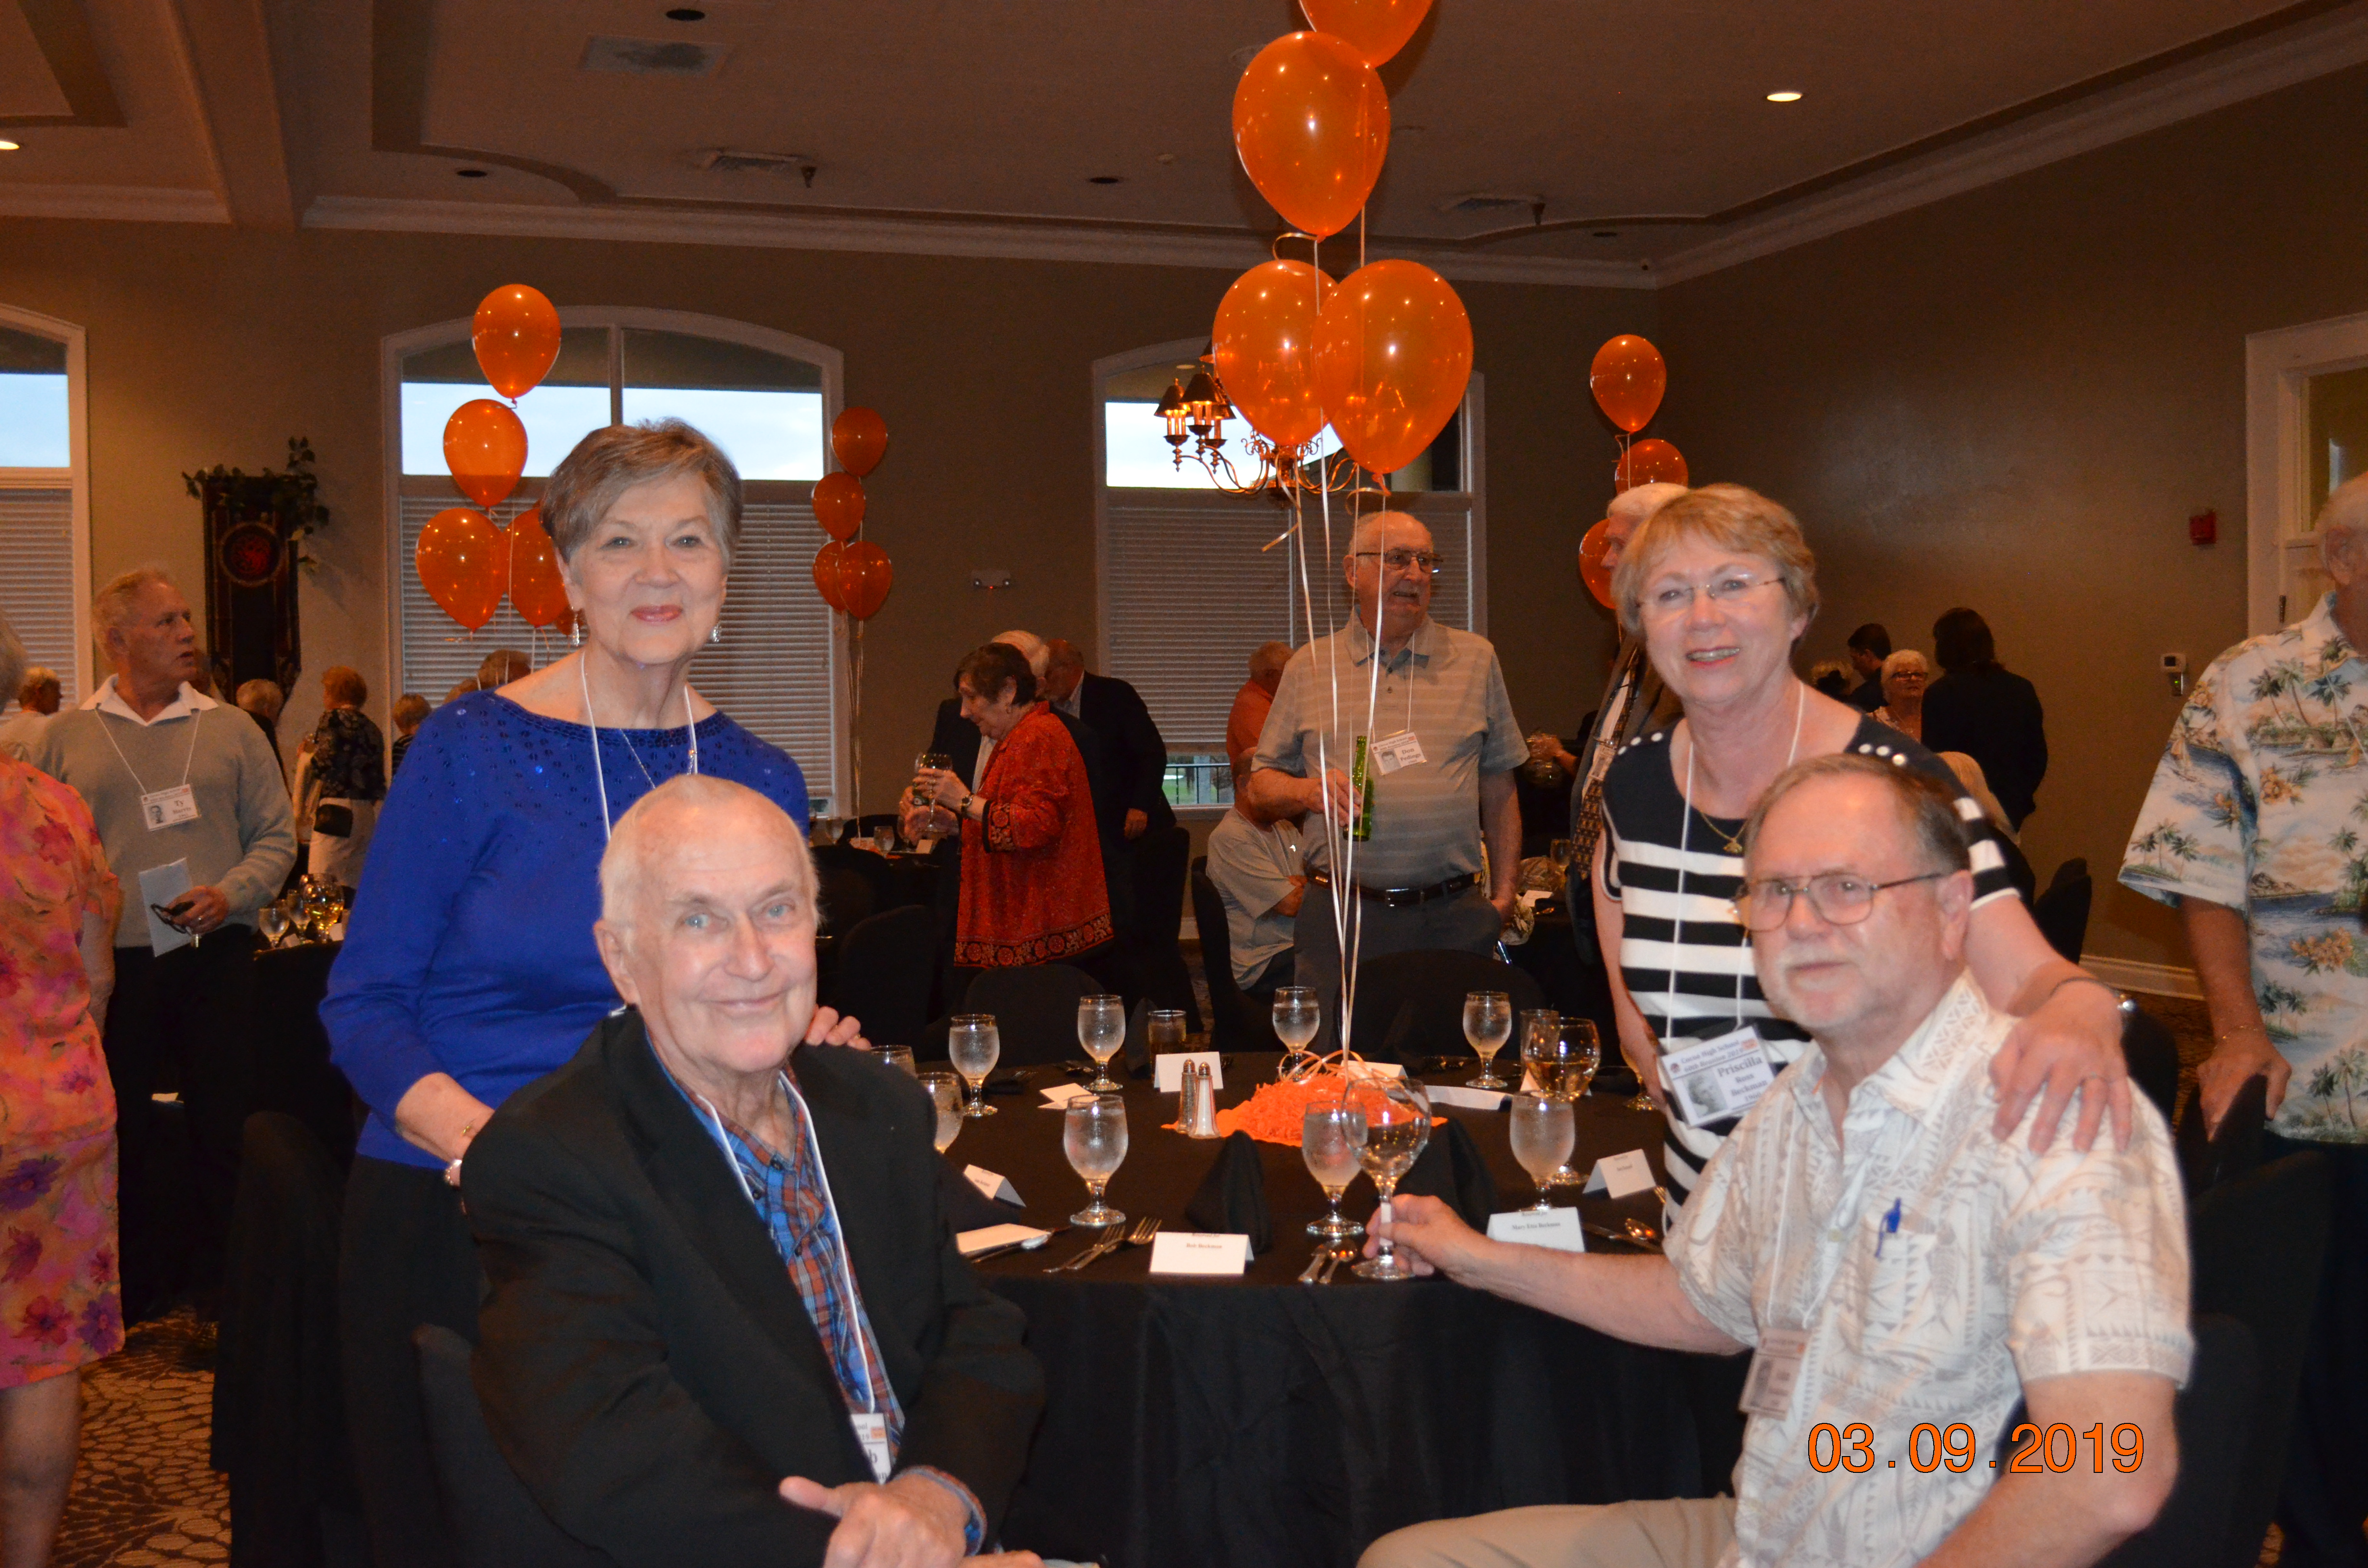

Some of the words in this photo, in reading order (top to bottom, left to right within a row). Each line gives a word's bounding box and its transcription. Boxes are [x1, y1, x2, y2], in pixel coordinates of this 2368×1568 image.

[1400, 753, 1421, 761] Pedings
[1702, 1048, 1717, 1057] High
[1717, 1040, 1739, 1052] School
[1700, 1055, 1727, 1067] Reunion
[1717, 1057, 1764, 1077] Priscilla
[1735, 1074, 1754, 1083] Ross
[1731, 1080, 1767, 1096] Beckman
